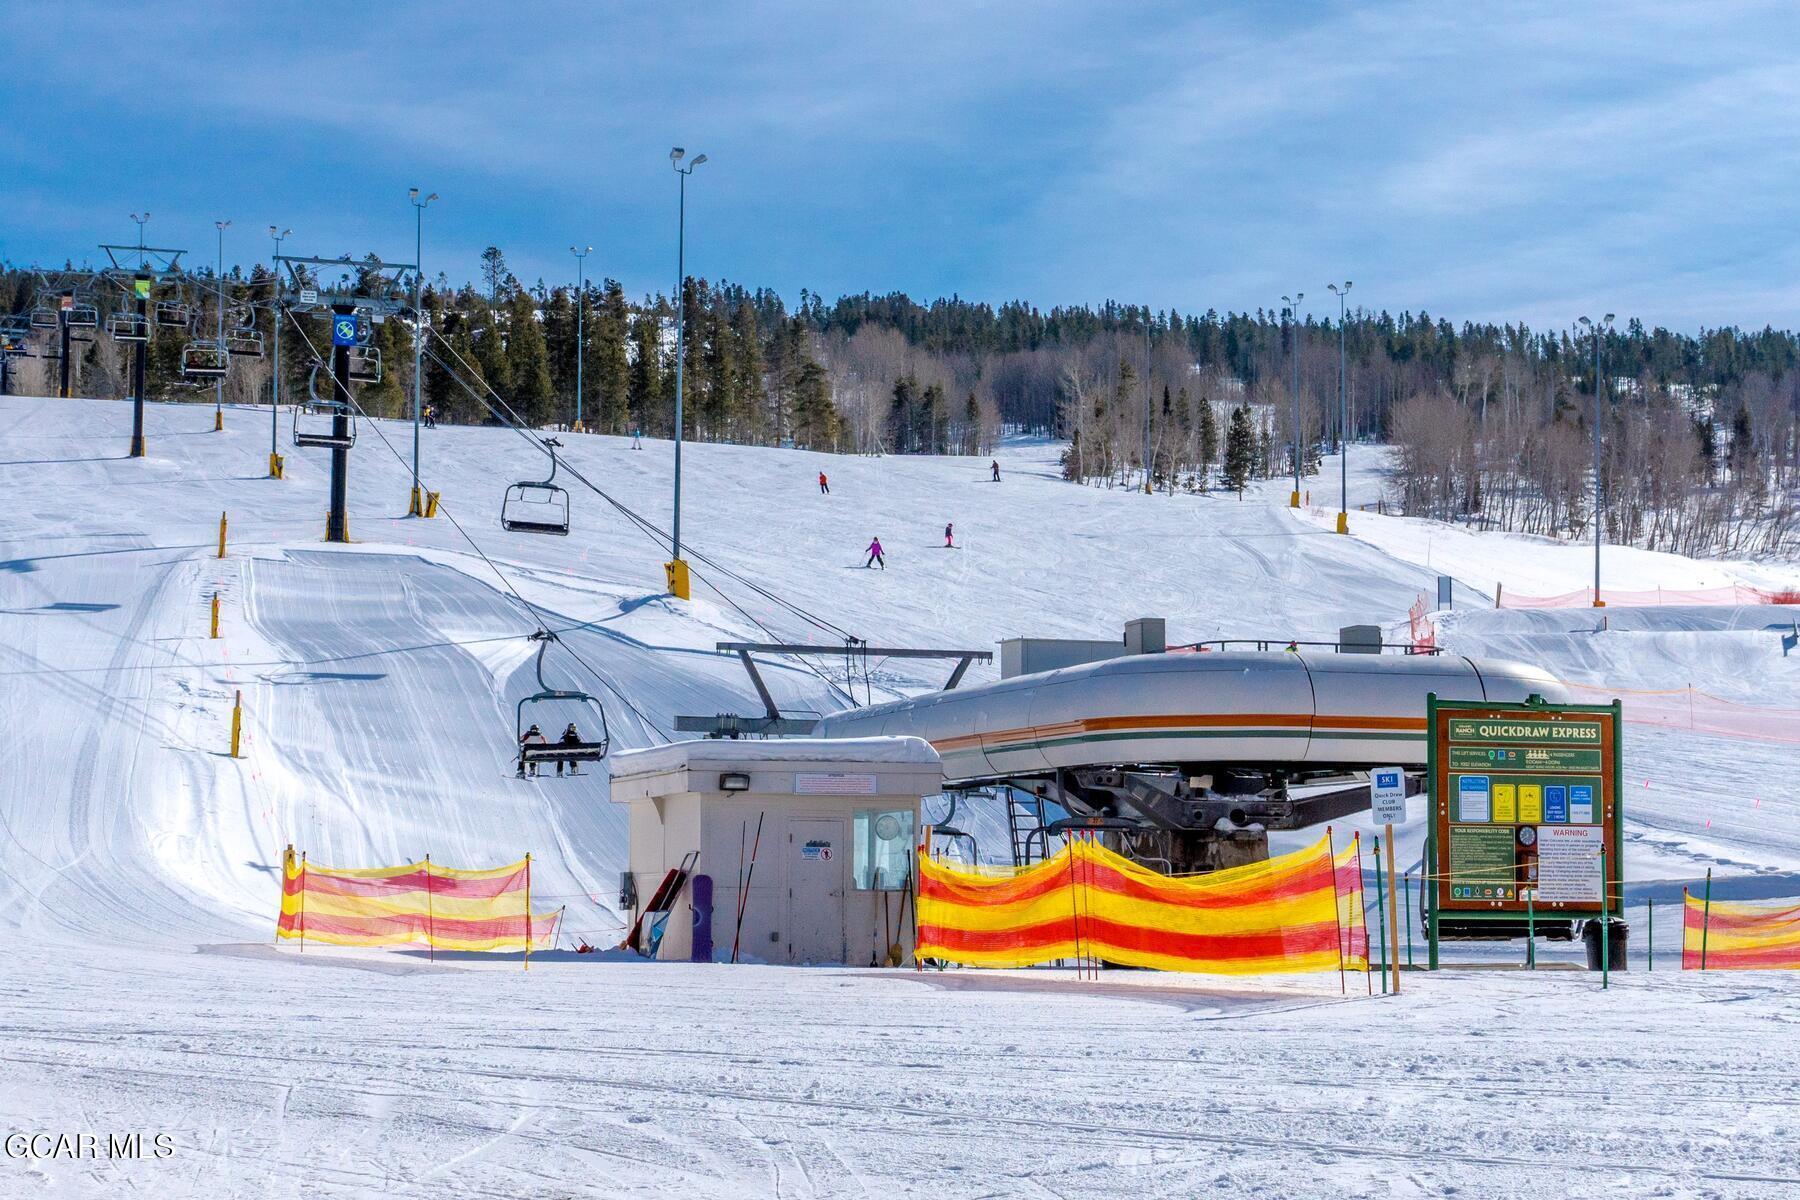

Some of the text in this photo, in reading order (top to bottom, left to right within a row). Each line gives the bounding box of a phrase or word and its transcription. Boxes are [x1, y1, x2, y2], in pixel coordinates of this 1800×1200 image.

[1479, 725, 1597, 739] QUICKDRAW EXPRESS
[1552, 829, 1588, 837] WARNING
